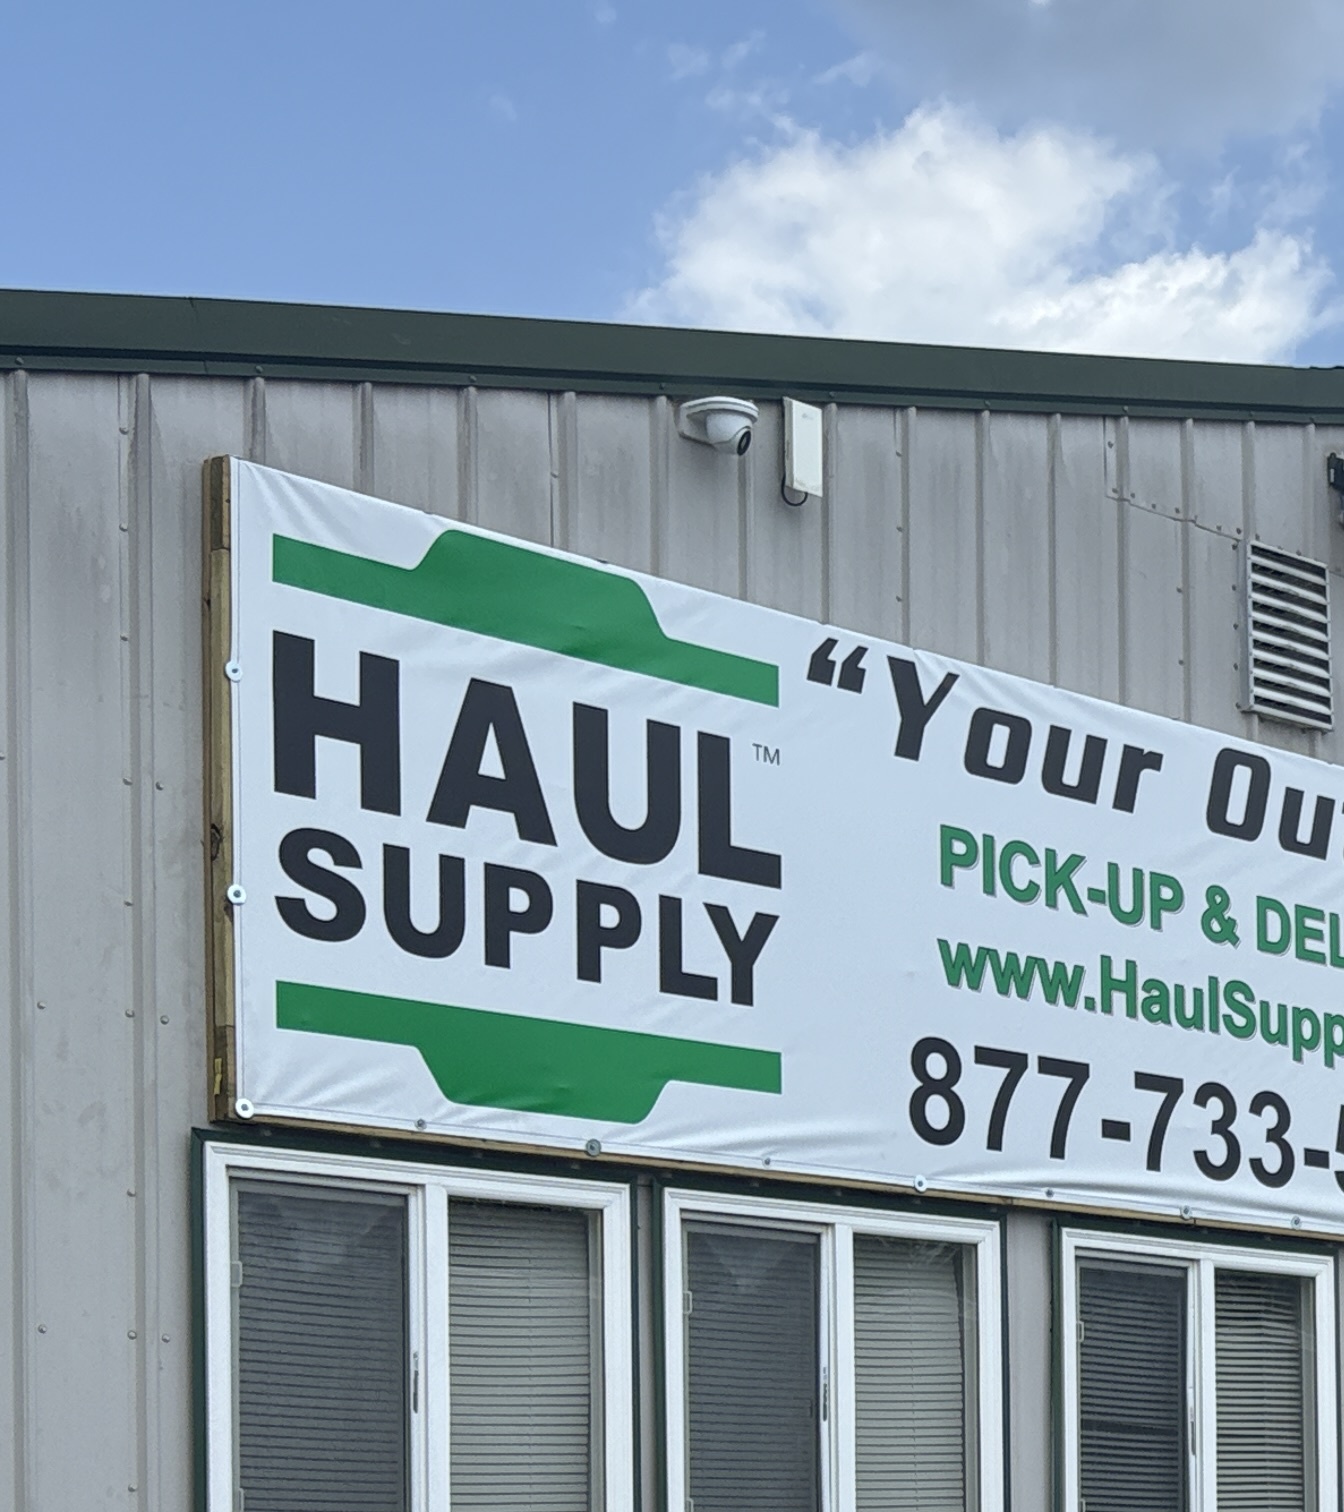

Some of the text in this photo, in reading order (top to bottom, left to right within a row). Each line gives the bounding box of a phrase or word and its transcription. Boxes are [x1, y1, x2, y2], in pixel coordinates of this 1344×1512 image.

[272, 629, 782, 890] HAUL
[274, 826, 780, 1008] SUPPLY
[940, 823, 1184, 931] PICK-UP
[1200, 884, 1240, 947] &
